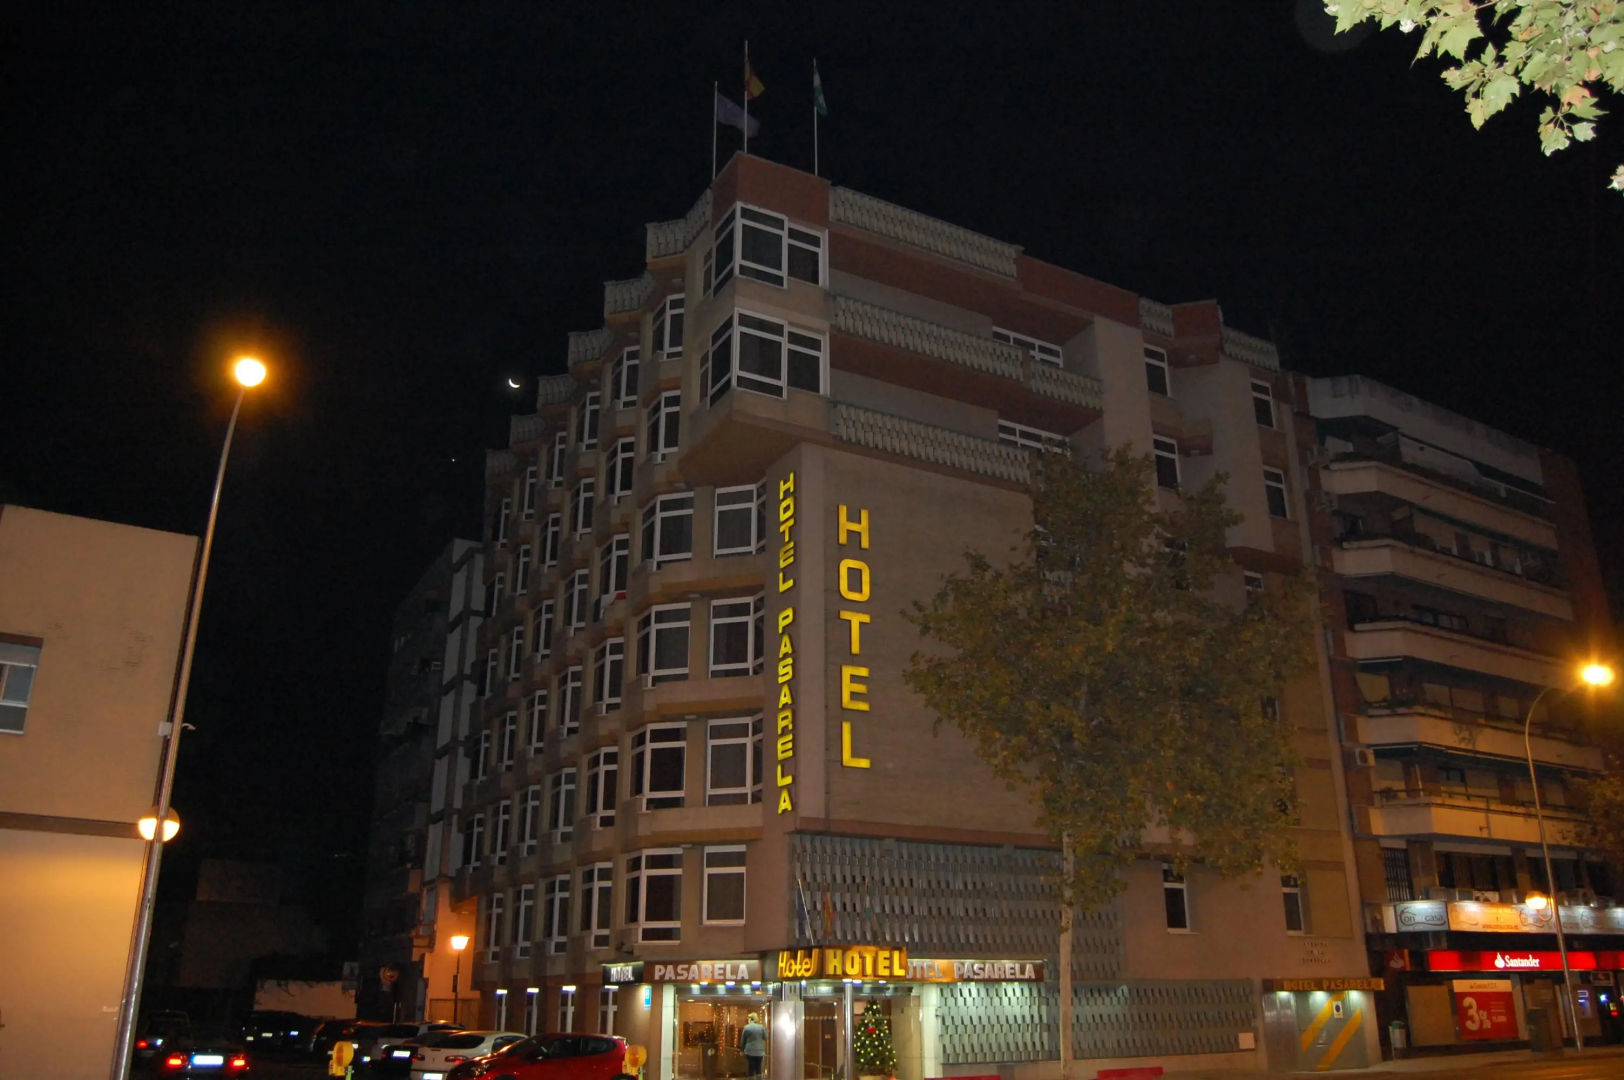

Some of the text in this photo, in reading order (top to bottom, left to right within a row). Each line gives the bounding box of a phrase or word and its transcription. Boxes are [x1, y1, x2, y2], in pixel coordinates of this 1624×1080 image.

[777, 471, 795, 814] HOTEL PASARELA
[837, 504, 871, 770] HOTEL
[777, 948, 820, 978] Hotel
[825, 948, 906, 977] HOTEL
[1504, 954, 1540, 967] Santander
[610, 966, 635, 982] HOTEL
[654, 963, 749, 980] PASARELA
[953, 962, 1036, 979] PASARELA
[1284, 980, 1317, 990] HOTEL
